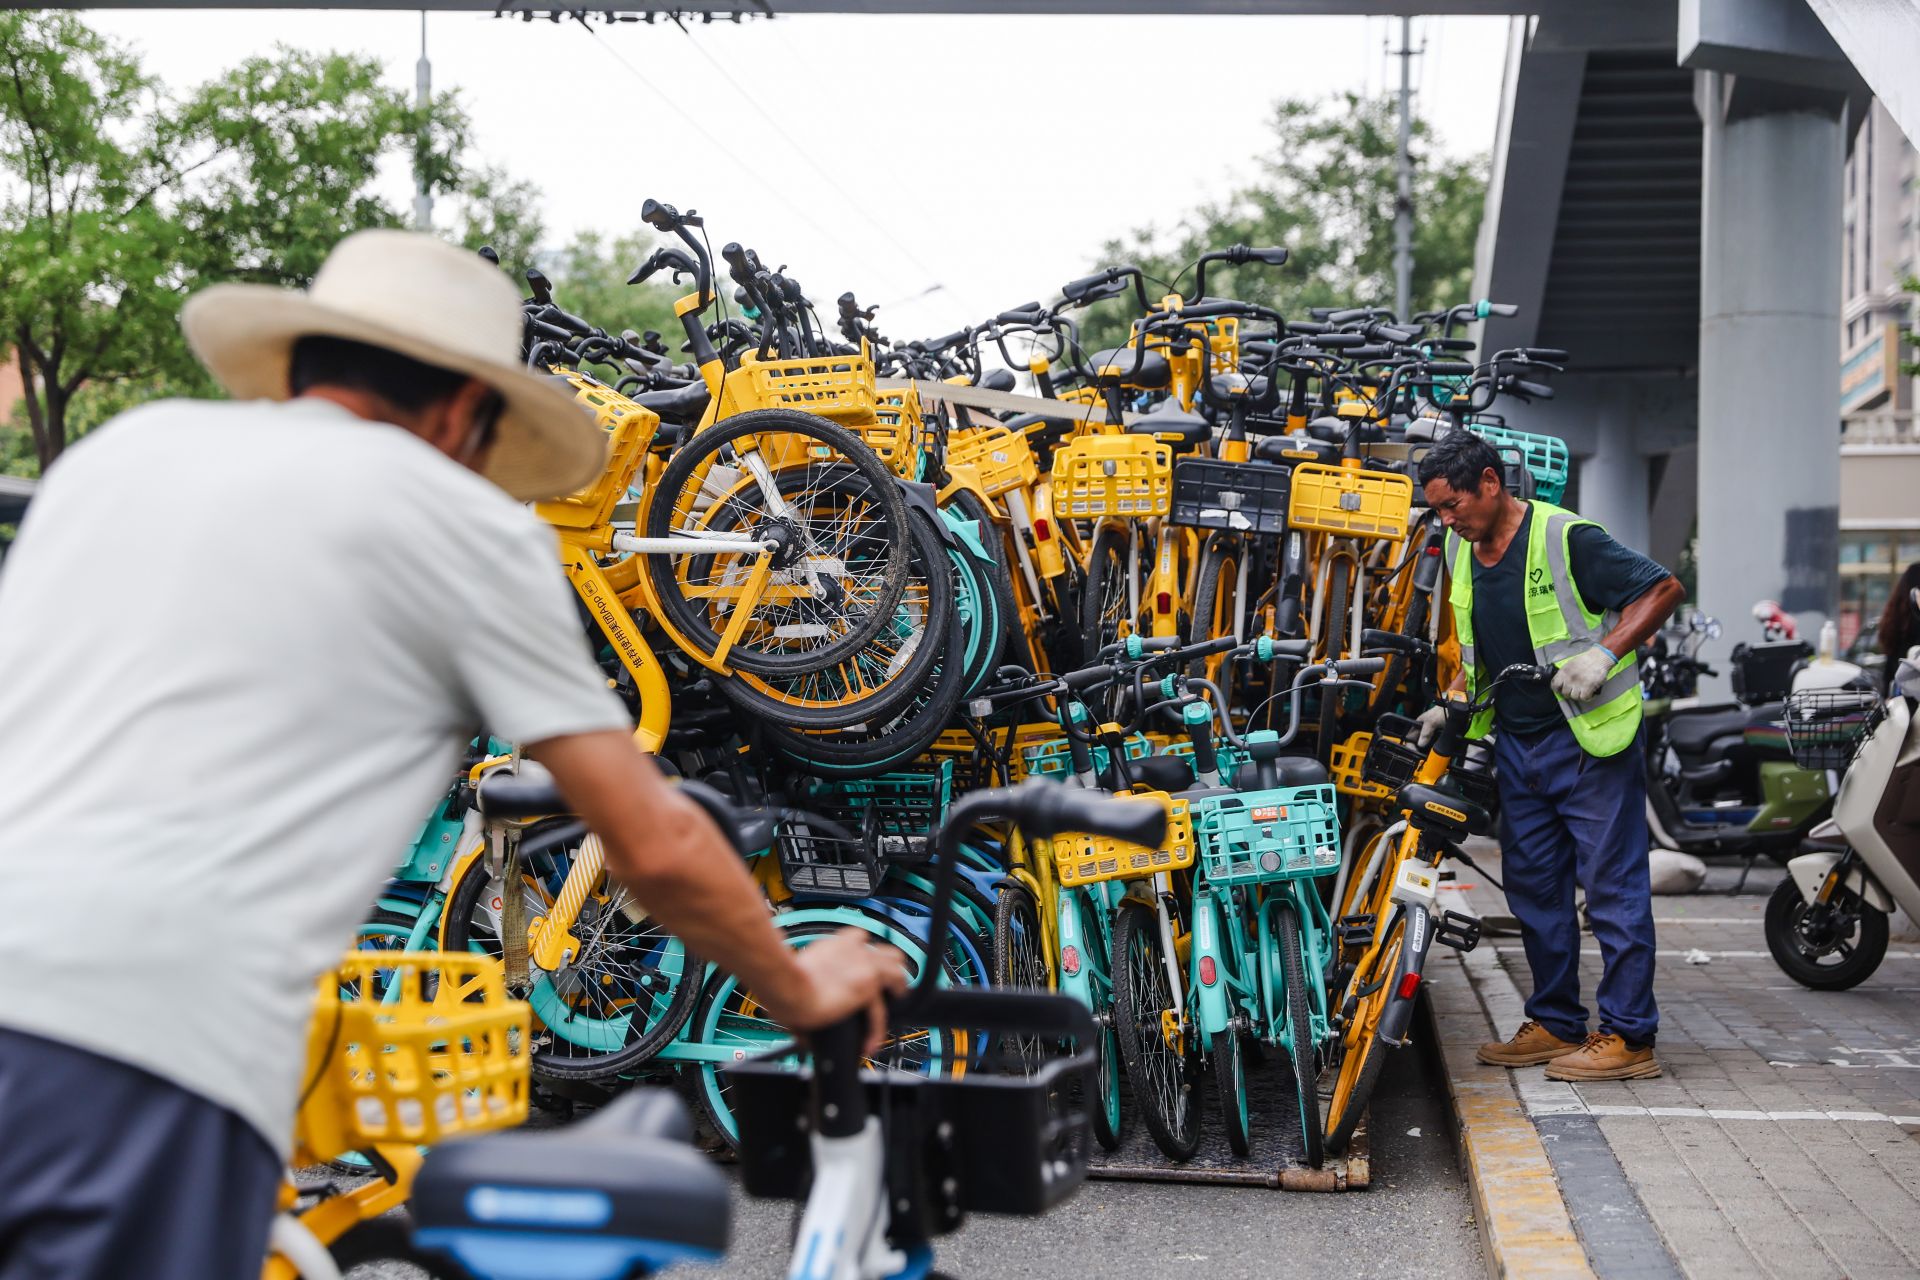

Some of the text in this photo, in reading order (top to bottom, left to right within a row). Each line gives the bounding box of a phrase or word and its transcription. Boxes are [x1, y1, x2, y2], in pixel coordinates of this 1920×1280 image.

[593, 595, 644, 668] 推荐使用美团App
